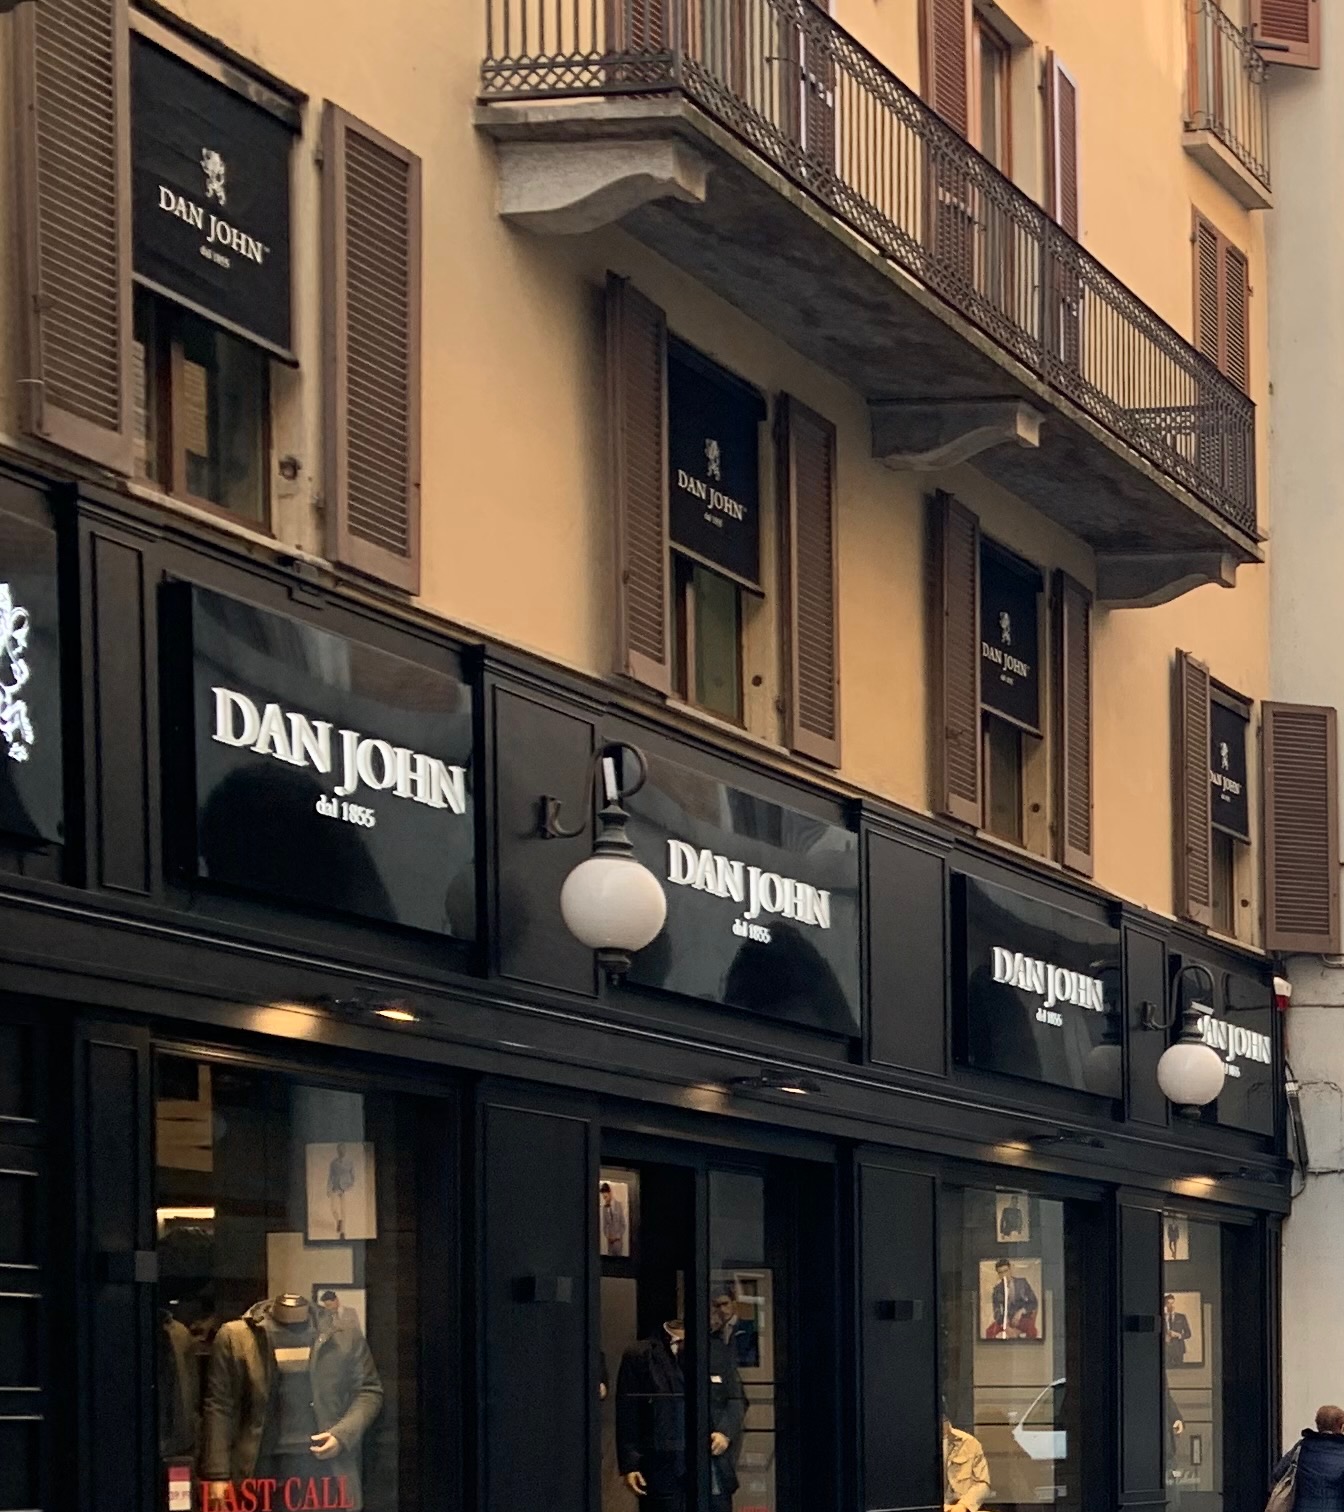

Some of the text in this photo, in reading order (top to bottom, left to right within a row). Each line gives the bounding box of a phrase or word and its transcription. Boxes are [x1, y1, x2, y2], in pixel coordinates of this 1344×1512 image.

[158, 184, 263, 265] DAN JOHN
[677, 468, 707, 500] DAN
[707, 488, 743, 521] JOHN
[981, 641, 1027, 678] DAN JOHN
[211, 686, 467, 816] DAN JOHN
[315, 794, 377, 829] dal 1855
[666, 838, 832, 930] DAN JOHN
[992, 945, 1104, 1013] DAN JOHN
[1196, 1014, 1272, 1065] AN JOHN
[284, 1475, 356, 1512] CALL
